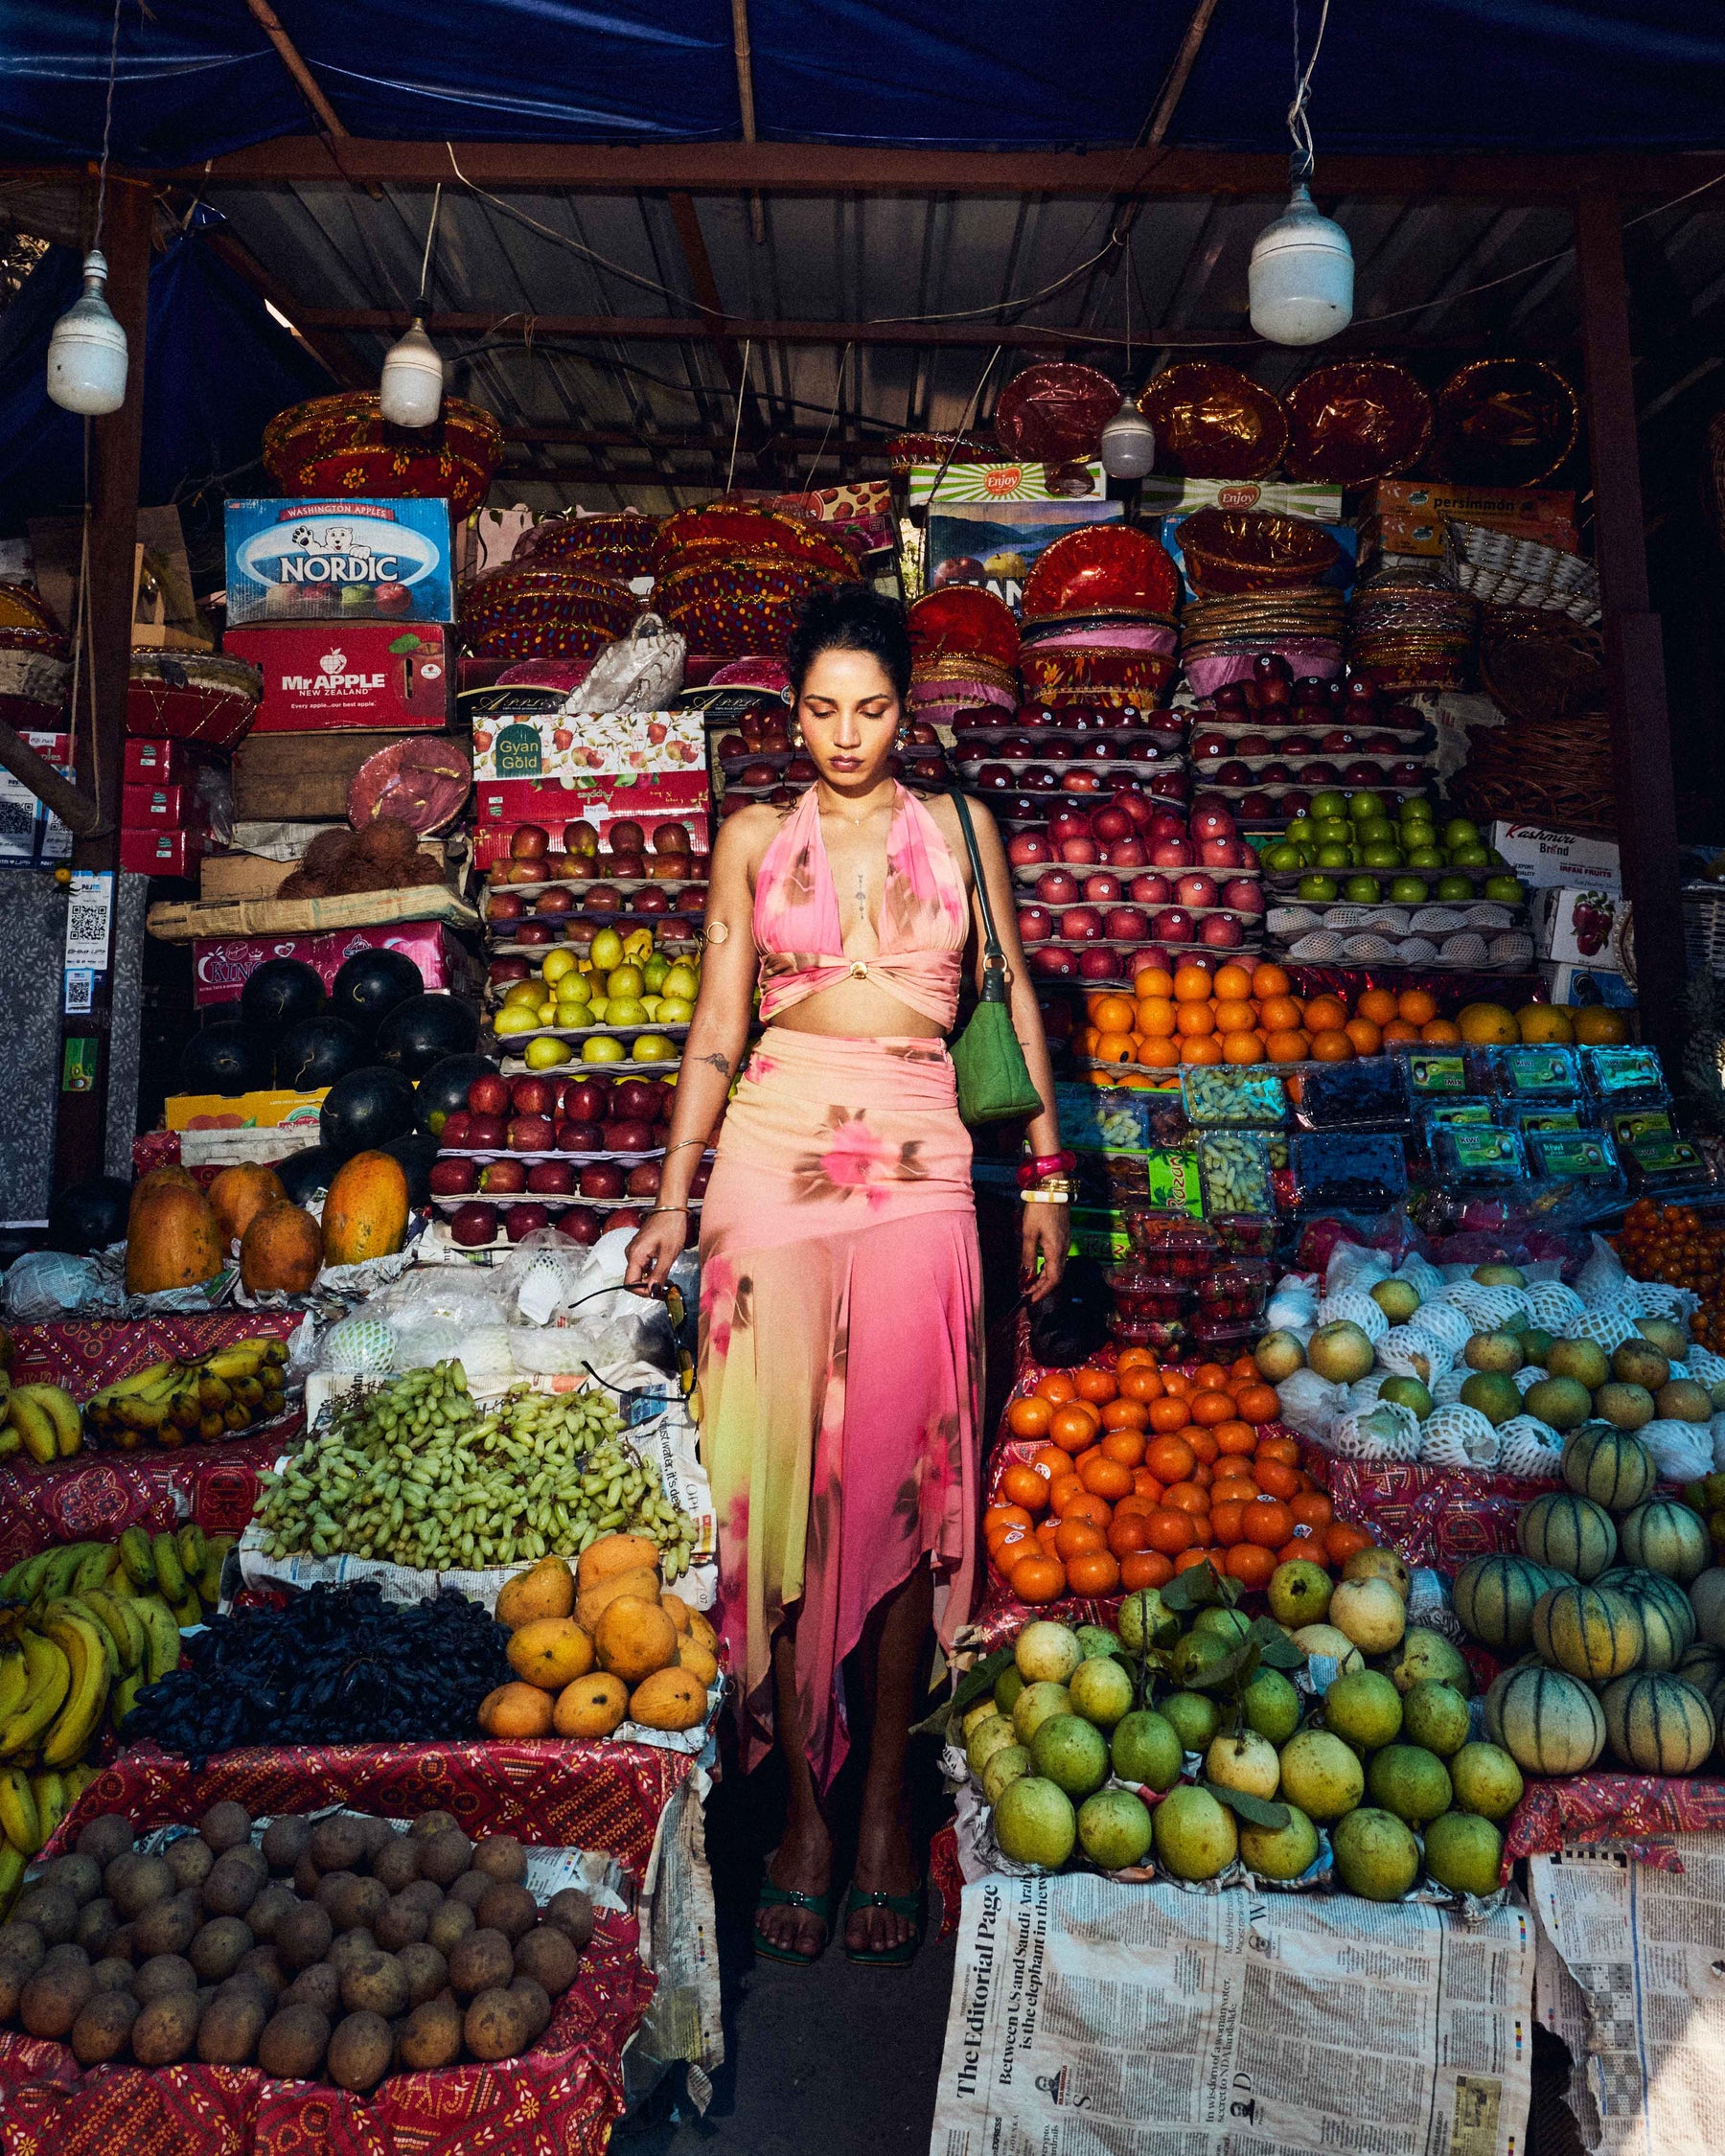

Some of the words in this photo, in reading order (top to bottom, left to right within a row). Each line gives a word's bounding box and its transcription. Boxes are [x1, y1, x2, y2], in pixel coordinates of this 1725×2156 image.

[987, 474, 1018, 488] Enjoy
[1222, 491, 1255, 505] Enjoy
[288, 505, 352, 517] WASHINGTON
[355, 506, 386, 517] APPLES
[279, 556, 399, 583] NORDIC
[282, 676, 312, 691] Mr
[313, 674, 385, 689] APPLE
[499, 740, 540, 754] Gyan
[1559, 865, 1582, 874] IRFAN
[1584, 867, 1612, 878] FRUITS
[1543, 1142, 1564, 1152] kiwi
[1166, 1155, 1186, 1208] Razan
[661, 1442, 673, 1472] water,
[700, 1594, 708, 1604] 07
[978, 1885, 1002, 1940] Page
[1035, 1892, 1048, 1916] the
[1249, 1901, 1267, 1922] W
[1015, 1912, 1031, 1958] Saudi
[1033, 1919, 1046, 1937] in
[1012, 1959, 1025, 1990] and
[1024, 1938, 1046, 2007] elephant
[963, 1943, 994, 2048] Editorial
[1007, 1991, 1022, 2013] US
[1022, 2007, 1036, 2034] the
[1215, 2007, 1227, 2045] woman
[1225, 2003, 1237, 2051] landslide
[999, 2016, 1019, 2085] Between
[1019, 2036, 1033, 2050] is
[1211, 2053, 1220, 2065] of
[1220, 2052, 1230, 2077] NDA
[956, 2051, 979, 2099] The
[1220, 2078, 1228, 2090] to
[1232, 2072, 1252, 2092] D
[1208, 2066, 1218, 2110] wisdom
[1206, 2111, 1215, 2123] In
[1217, 2091, 1227, 2123] secret
